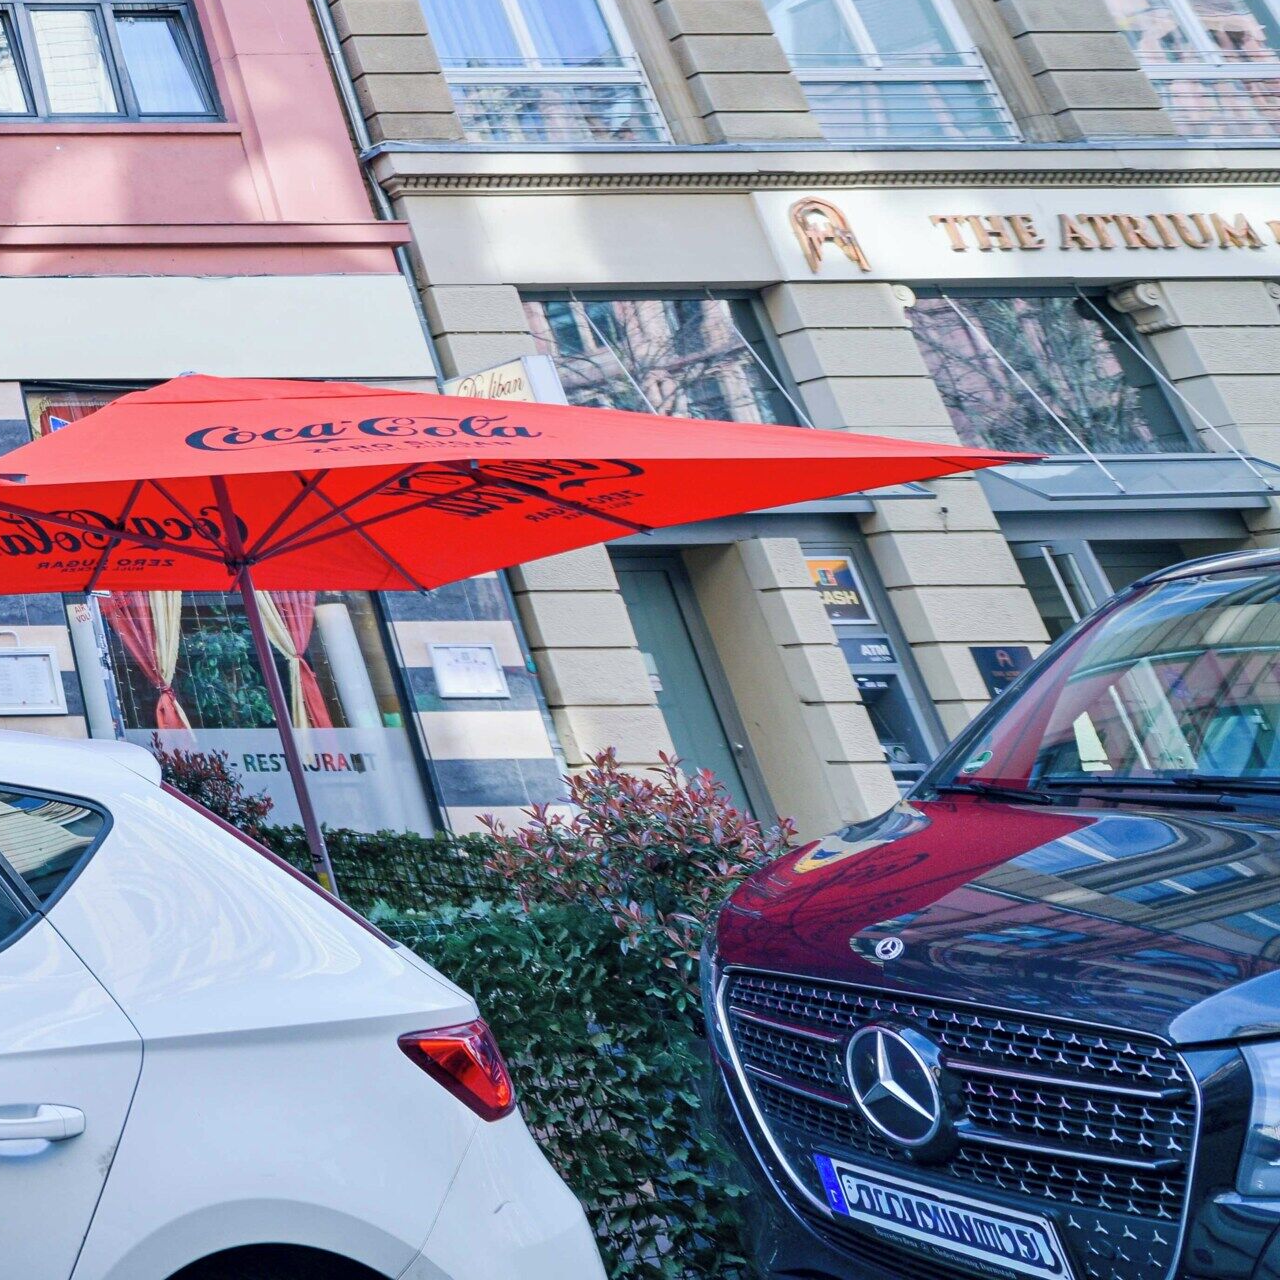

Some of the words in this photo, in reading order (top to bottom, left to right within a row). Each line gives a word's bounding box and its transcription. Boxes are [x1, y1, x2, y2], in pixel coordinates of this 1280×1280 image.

[930, 213, 1046, 252] THE
[1057, 212, 1269, 251] ATRIUM
[183, 415, 544, 452] Coca-Cola
[819, 590, 859, 605] ASH
[860, 644, 890, 656] ATM
